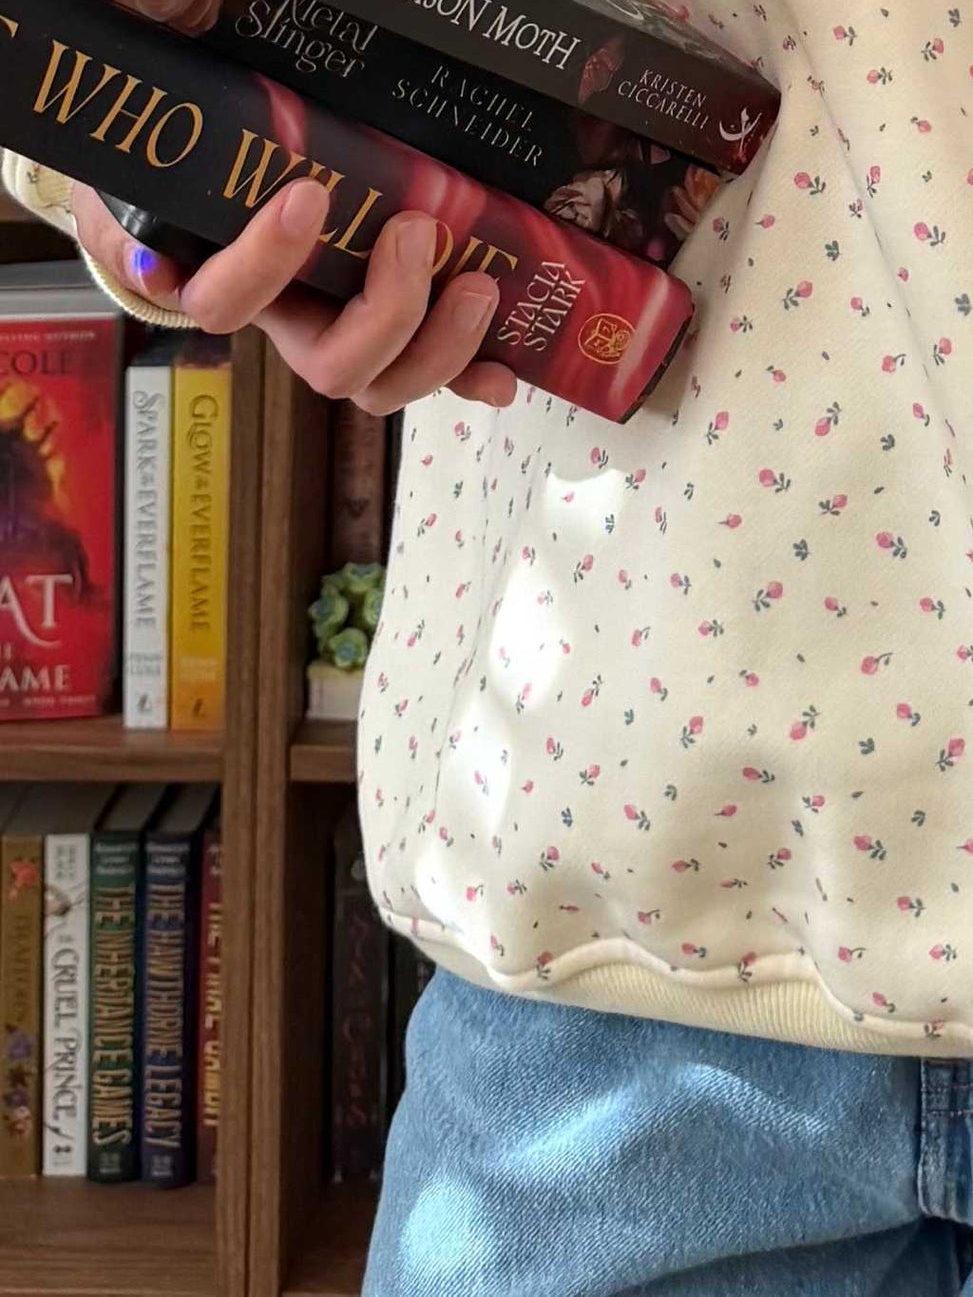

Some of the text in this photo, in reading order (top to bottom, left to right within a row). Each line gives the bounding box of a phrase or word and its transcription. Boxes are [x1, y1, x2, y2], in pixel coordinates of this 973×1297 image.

[483, 5, 582, 72] MOTH
[32, 38, 204, 169] WHO
[391, 78, 544, 167] SCHNEIDER
[430, 64, 535, 133] RACHEL
[616, 79, 710, 131] CICCARELLI
[638, 68, 707, 108] KRISTEN
[497, 259, 566, 348] STACIA
[522, 267, 587, 353] STARK
[132, 389, 163, 474] SPARK
[186, 393, 220, 477] GLOW
[135, 488, 159, 630] EVERFLAME
[188, 493, 212, 633] EVERFLAME
[93, 883, 136, 923] THE
[148, 883, 185, 921] THE
[53, 947, 80, 1029] CRUEL
[93, 929, 134, 1063] INHERITANCE
[146, 930, 184, 1058] HAWTHORNE
[52, 1034, 83, 1122] PRINCE
[92, 1067, 133, 1145] GAMES
[145, 1064, 183, 1149] LEGACY
